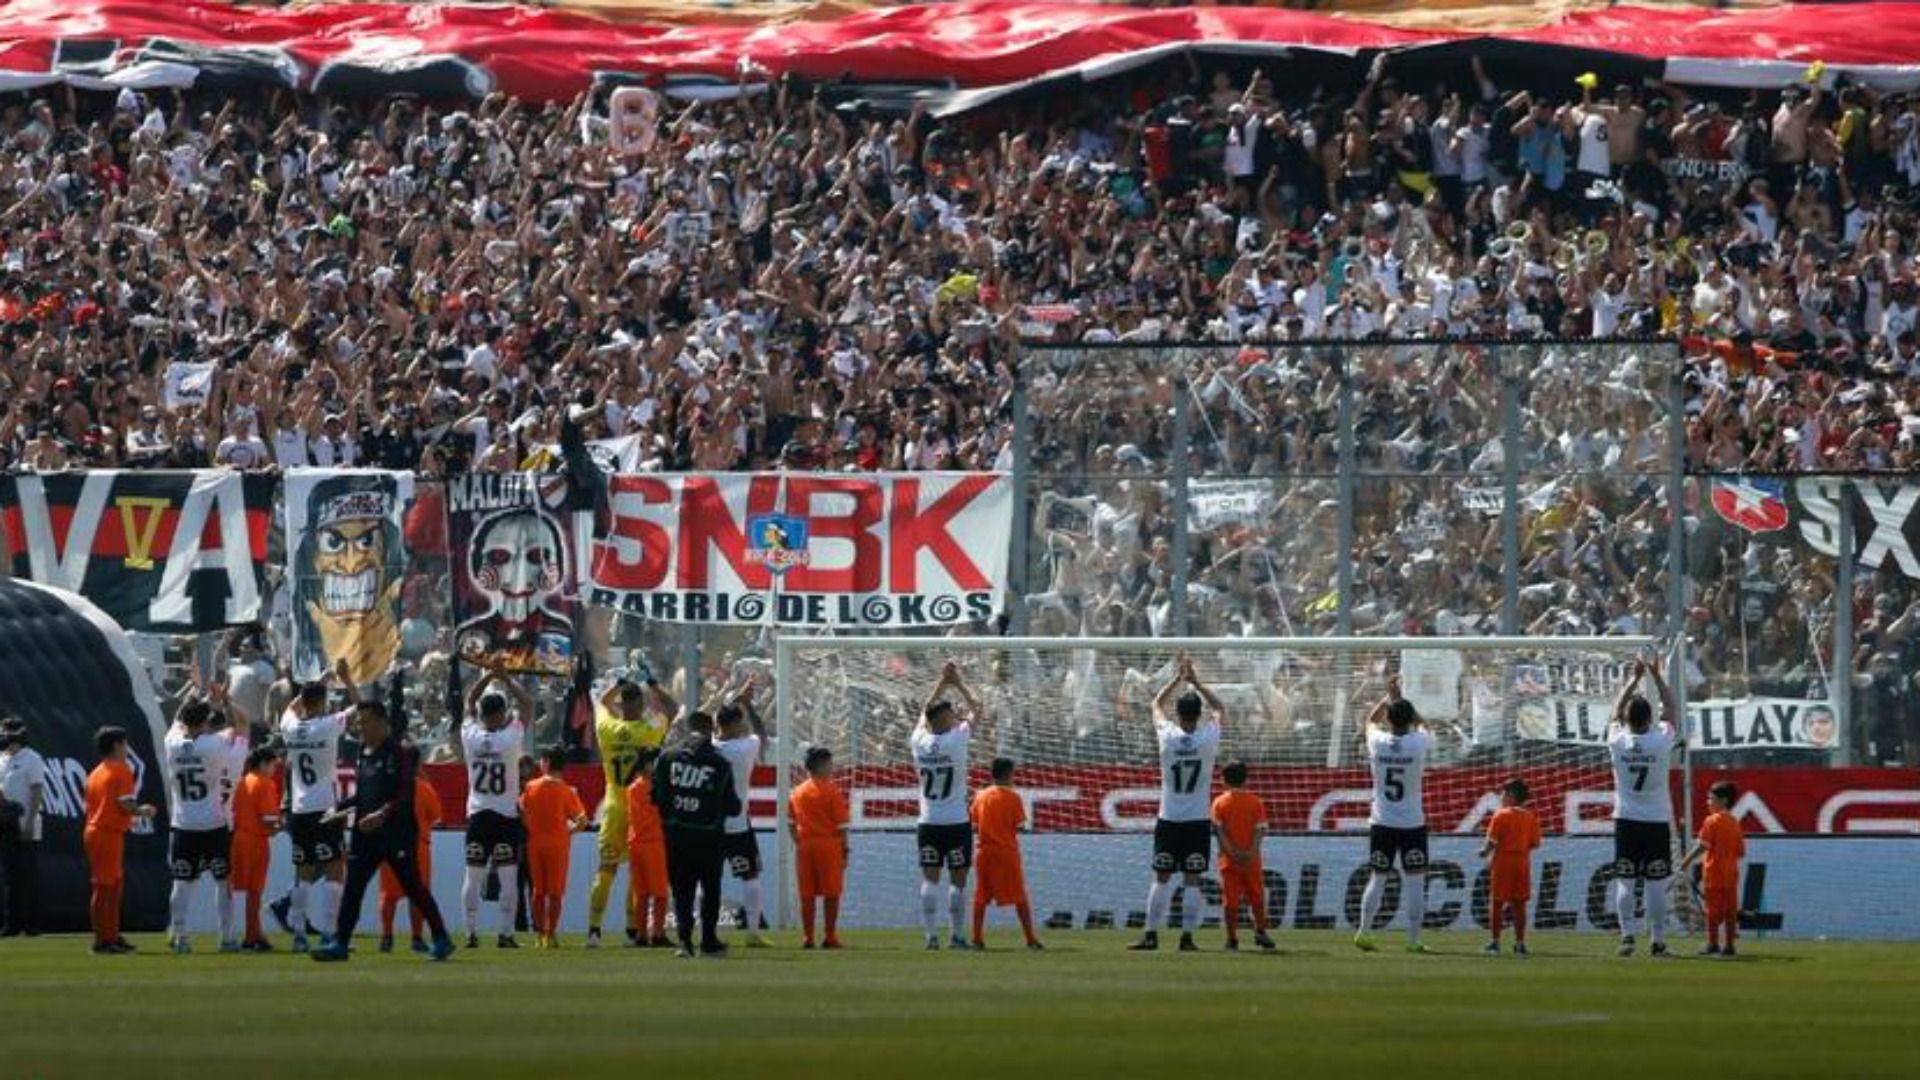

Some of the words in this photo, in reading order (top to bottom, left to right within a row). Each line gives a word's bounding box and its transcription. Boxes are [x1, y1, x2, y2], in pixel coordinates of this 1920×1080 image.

[591, 476, 1002, 594] SNBK
[778, 593, 828, 622] DE
[1701, 703, 1799, 746] LLAY
[175, 766, 207, 802] 15
[299, 753, 318, 786] 6
[472, 761, 507, 795] 28
[670, 761, 716, 788] CDF
[920, 766, 954, 800] 27
[1171, 759, 1202, 793] 17
[1384, 767, 1405, 802] 5
[1629, 766, 1649, 792] 7
